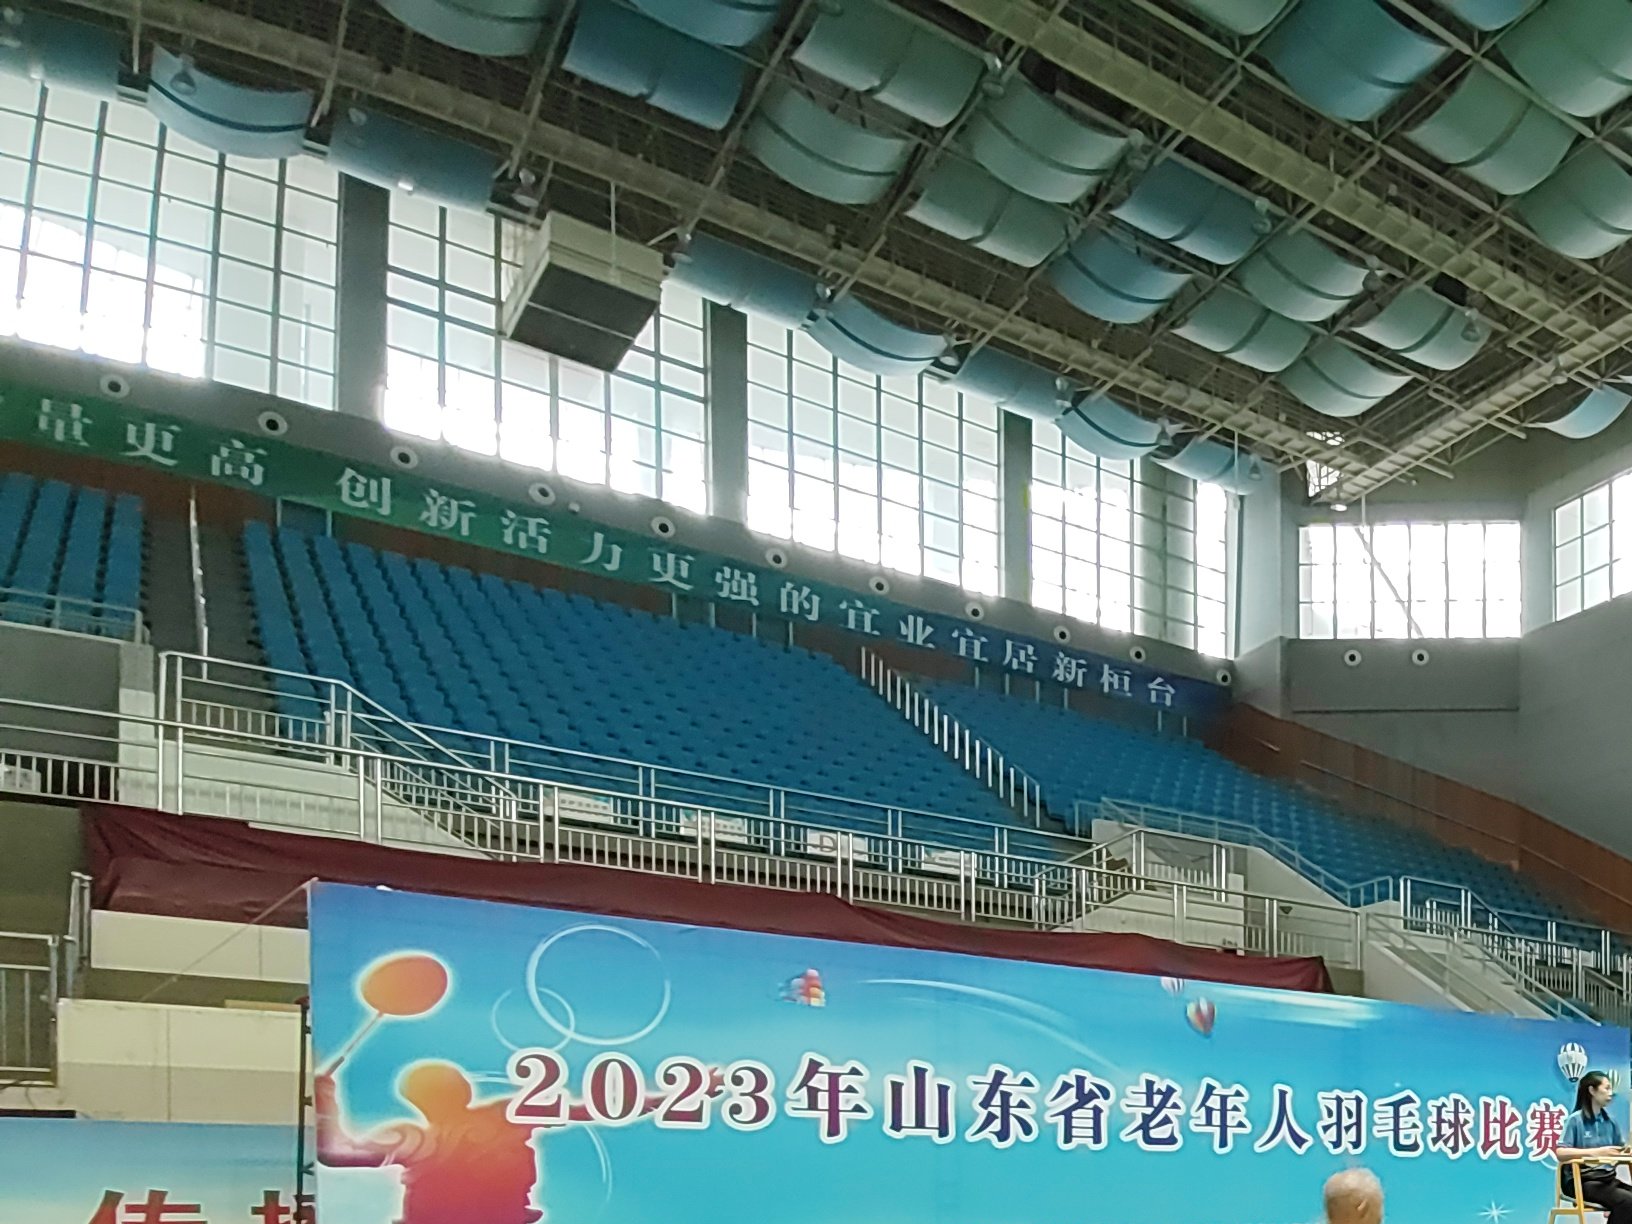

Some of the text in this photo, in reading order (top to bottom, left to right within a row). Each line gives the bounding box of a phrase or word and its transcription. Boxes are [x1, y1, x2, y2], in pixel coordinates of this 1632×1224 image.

[512, 1050, 1567, 1160] 2023年山东省老年人羽毛球比赛
